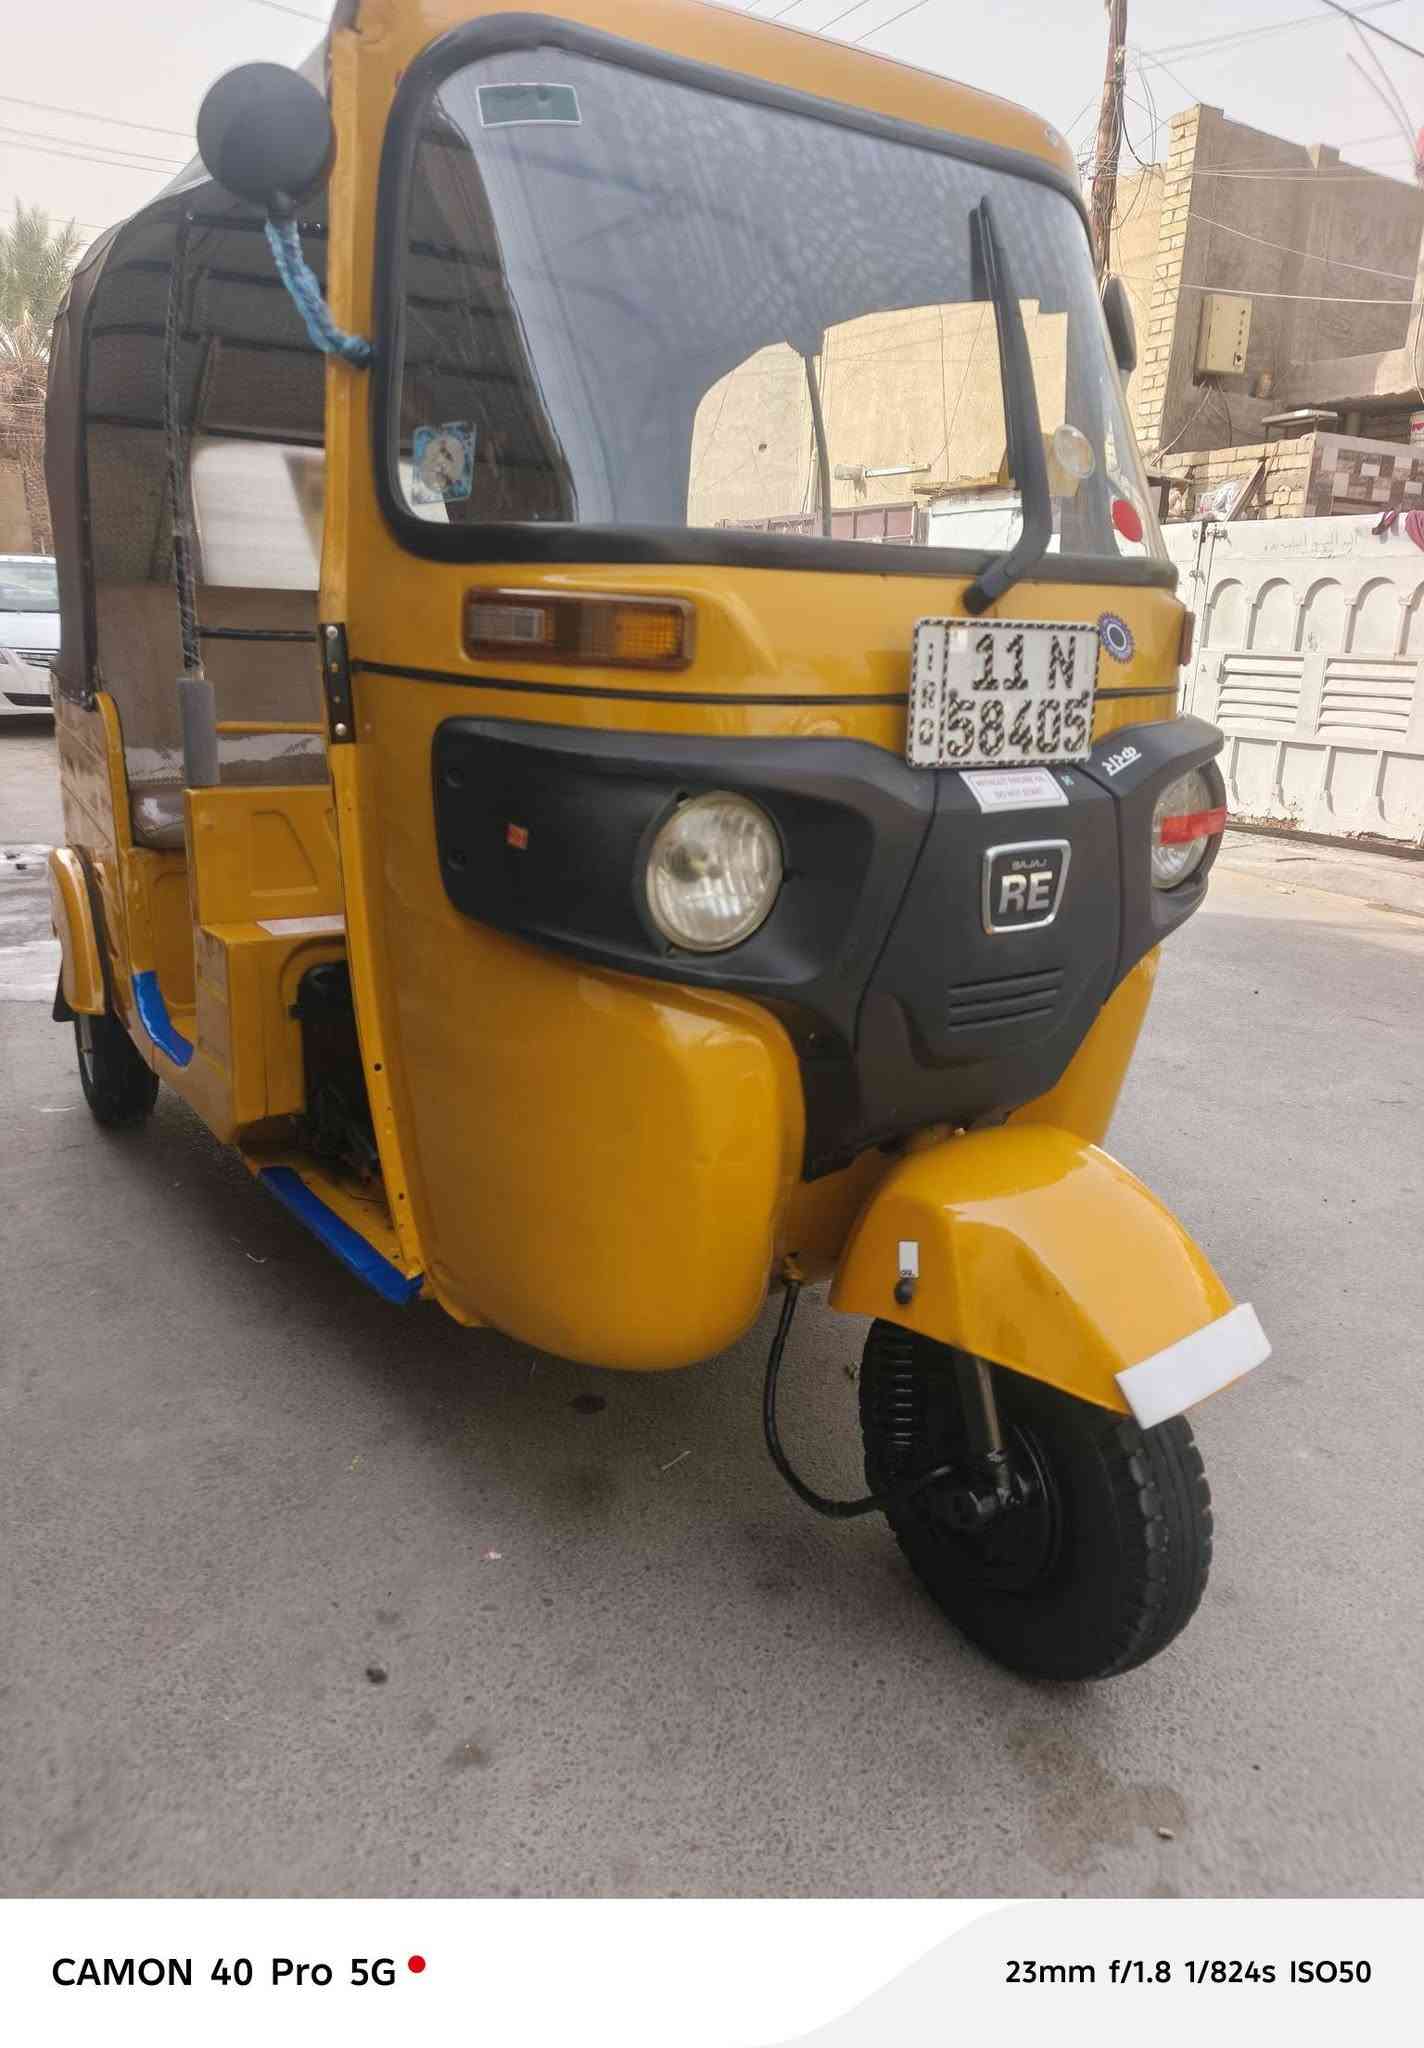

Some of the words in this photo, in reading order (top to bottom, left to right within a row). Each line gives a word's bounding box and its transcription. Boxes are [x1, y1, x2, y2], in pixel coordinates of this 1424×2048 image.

[971, 633, 1029, 691] 11
[1048, 634, 1076, 690] N
[946, 698, 1090, 758] 58405
[998, 870, 1053, 913] RE
